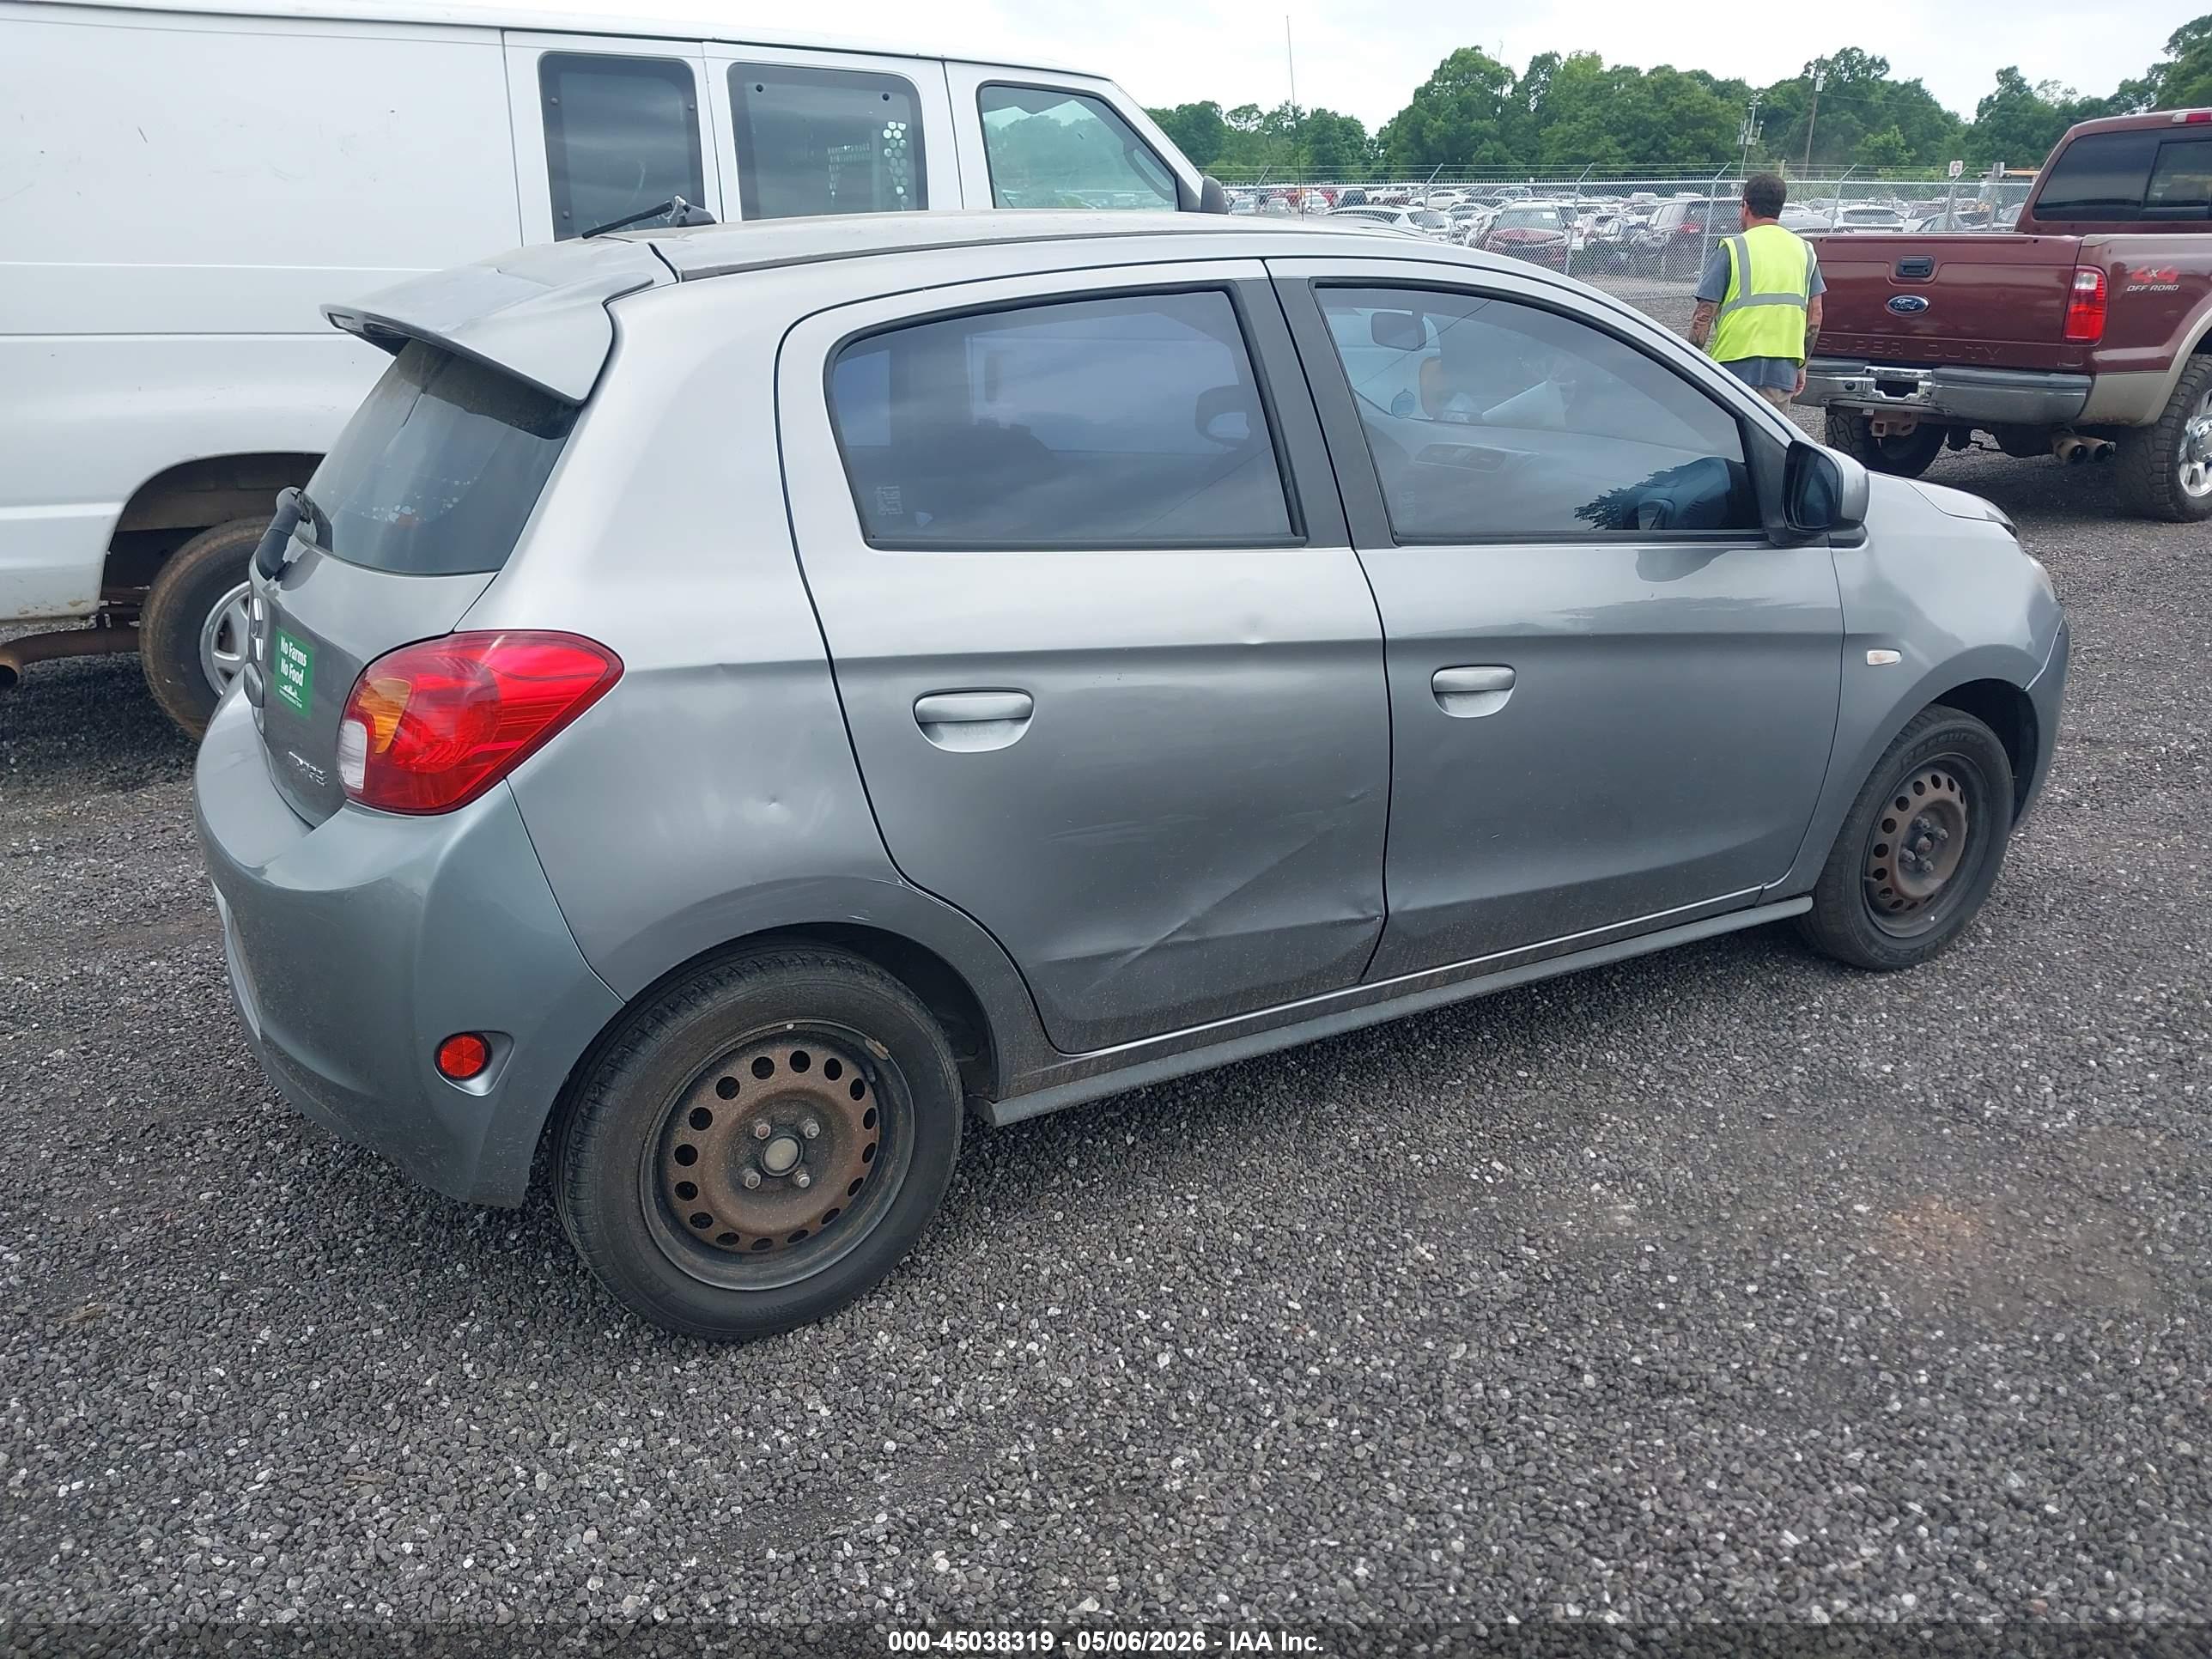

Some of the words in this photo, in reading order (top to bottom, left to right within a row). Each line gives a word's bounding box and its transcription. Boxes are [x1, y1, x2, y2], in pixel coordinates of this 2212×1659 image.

[1891, 298, 1917, 310] Ford
[1816, 337, 1904, 356] SUPER
[1923, 343, 2002, 361] DUTY
[281, 636, 289, 655] No
[289, 641, 307, 667] Farms
[281, 658, 289, 677] No
[289, 663, 304, 687] Food
